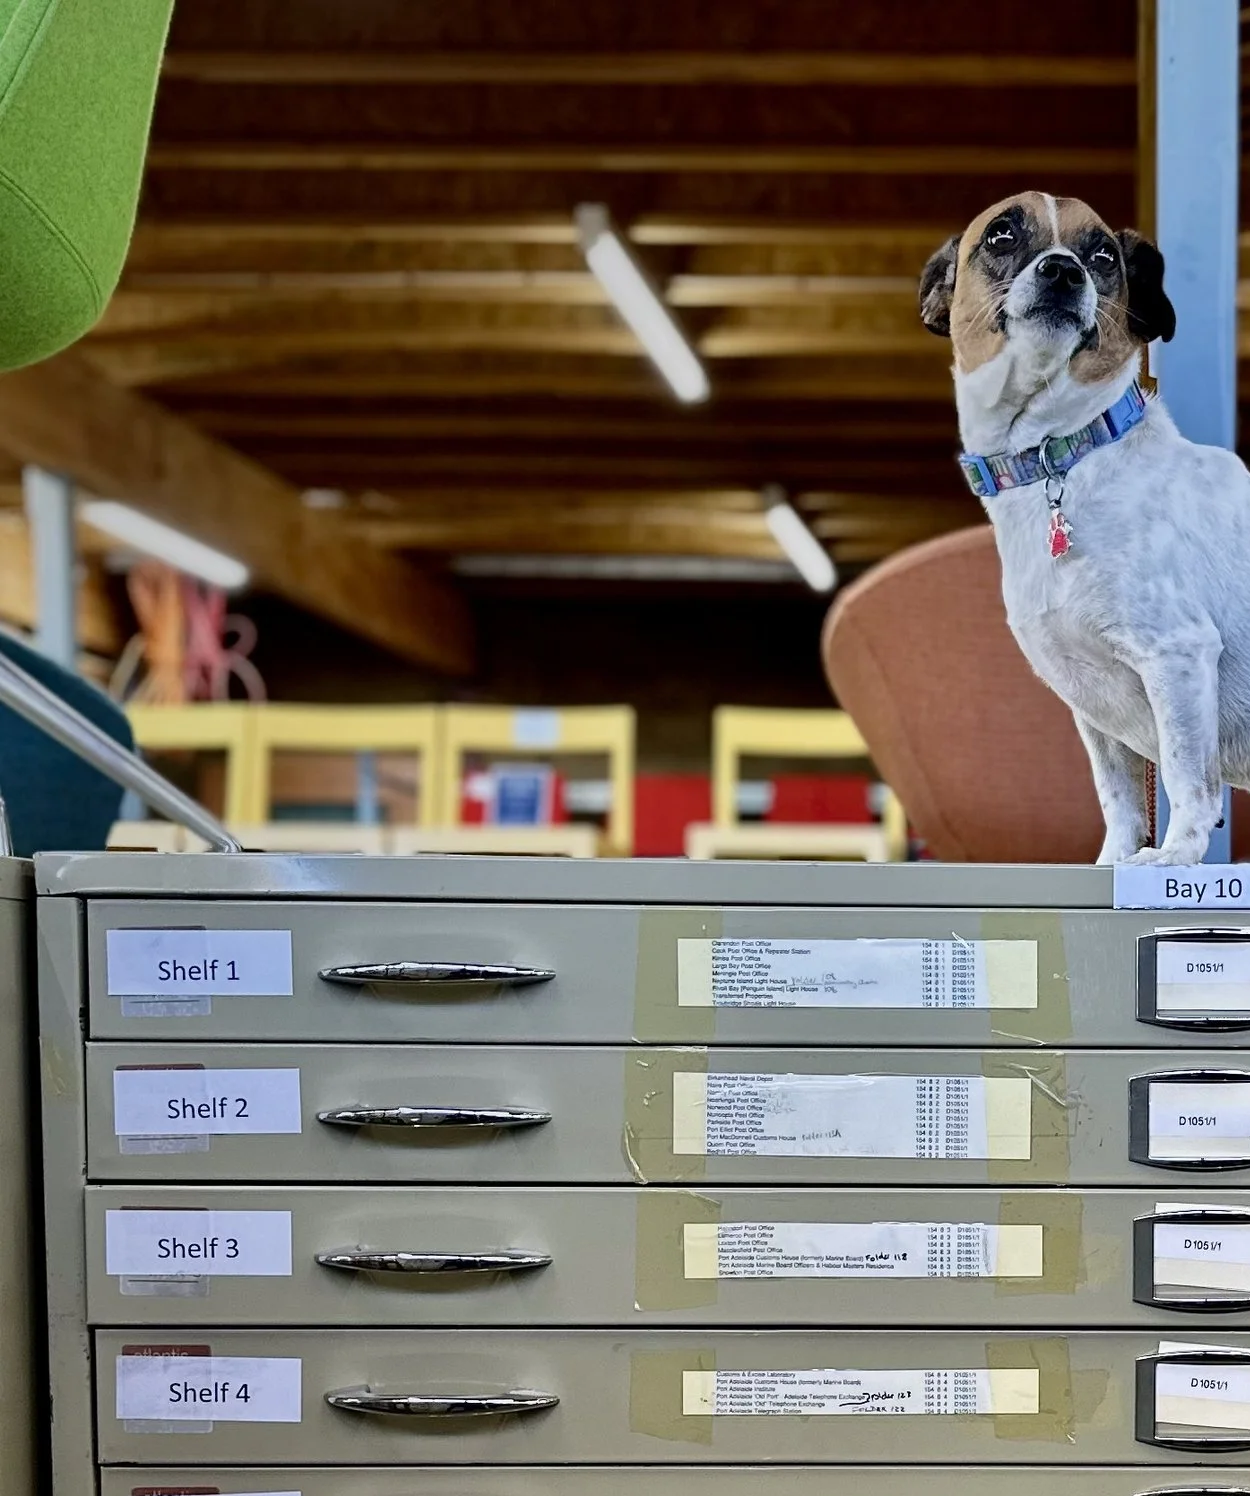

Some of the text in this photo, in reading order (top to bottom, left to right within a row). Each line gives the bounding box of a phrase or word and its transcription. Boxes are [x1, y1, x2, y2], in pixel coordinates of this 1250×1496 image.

[1165, 879, 1242, 904] Bay 10
[159, 960, 239, 981] Shelf 1
[168, 1097, 248, 1119] Shelf 2
[158, 1238, 238, 1258] Shelf 3
[170, 1382, 250, 1402] Shelf 4
